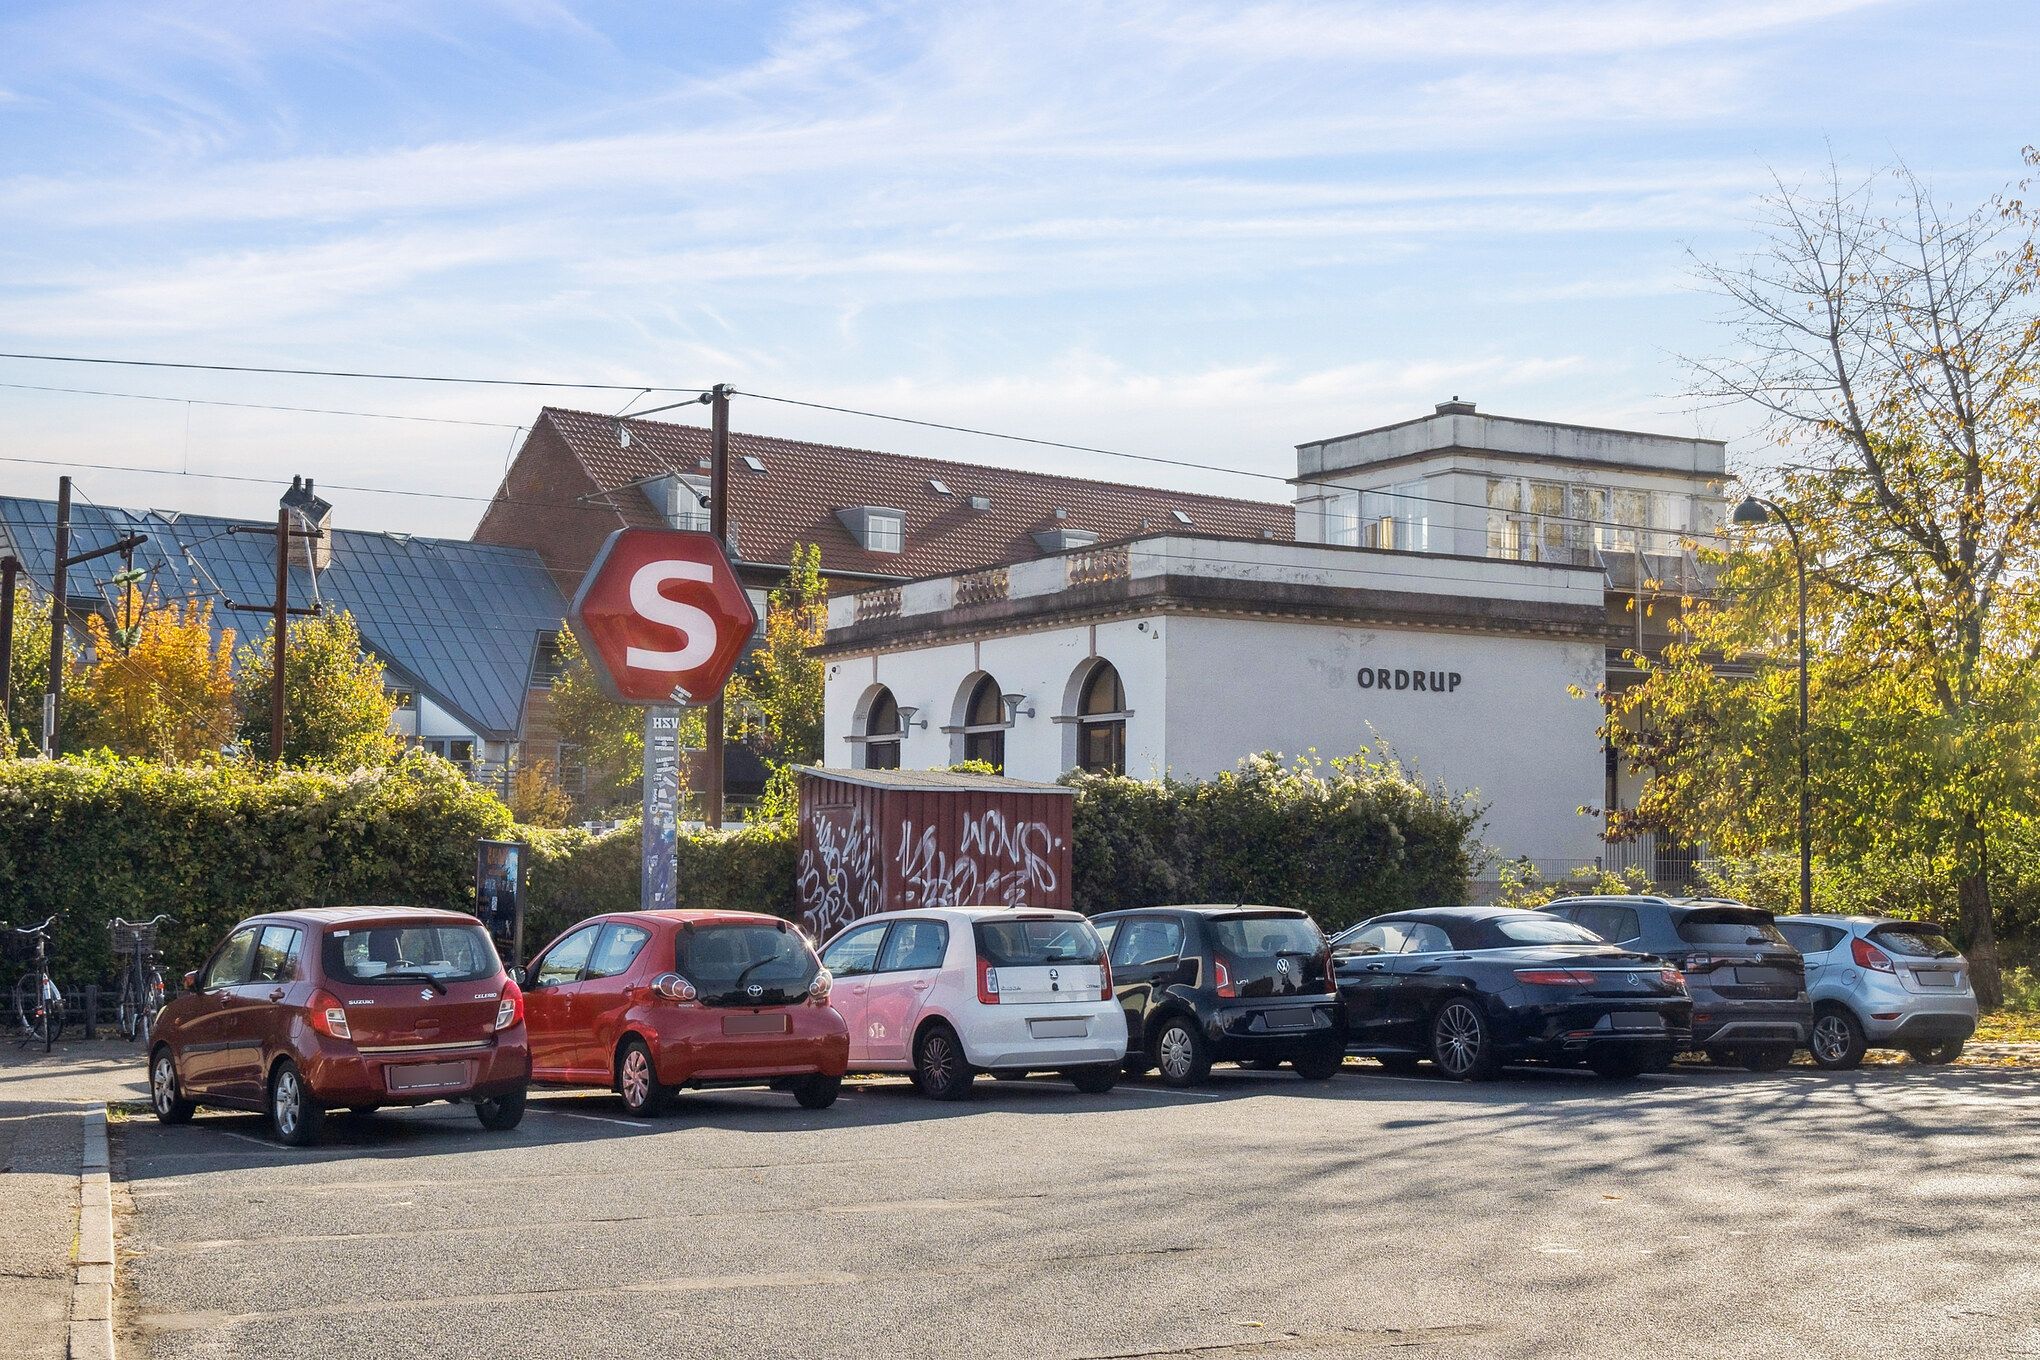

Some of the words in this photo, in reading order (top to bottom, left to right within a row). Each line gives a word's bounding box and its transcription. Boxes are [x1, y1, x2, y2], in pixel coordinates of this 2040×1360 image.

[626, 559, 717, 672] S
[1357, 667, 1462, 692] ORDRUP
[652, 717, 679, 729] HSV
